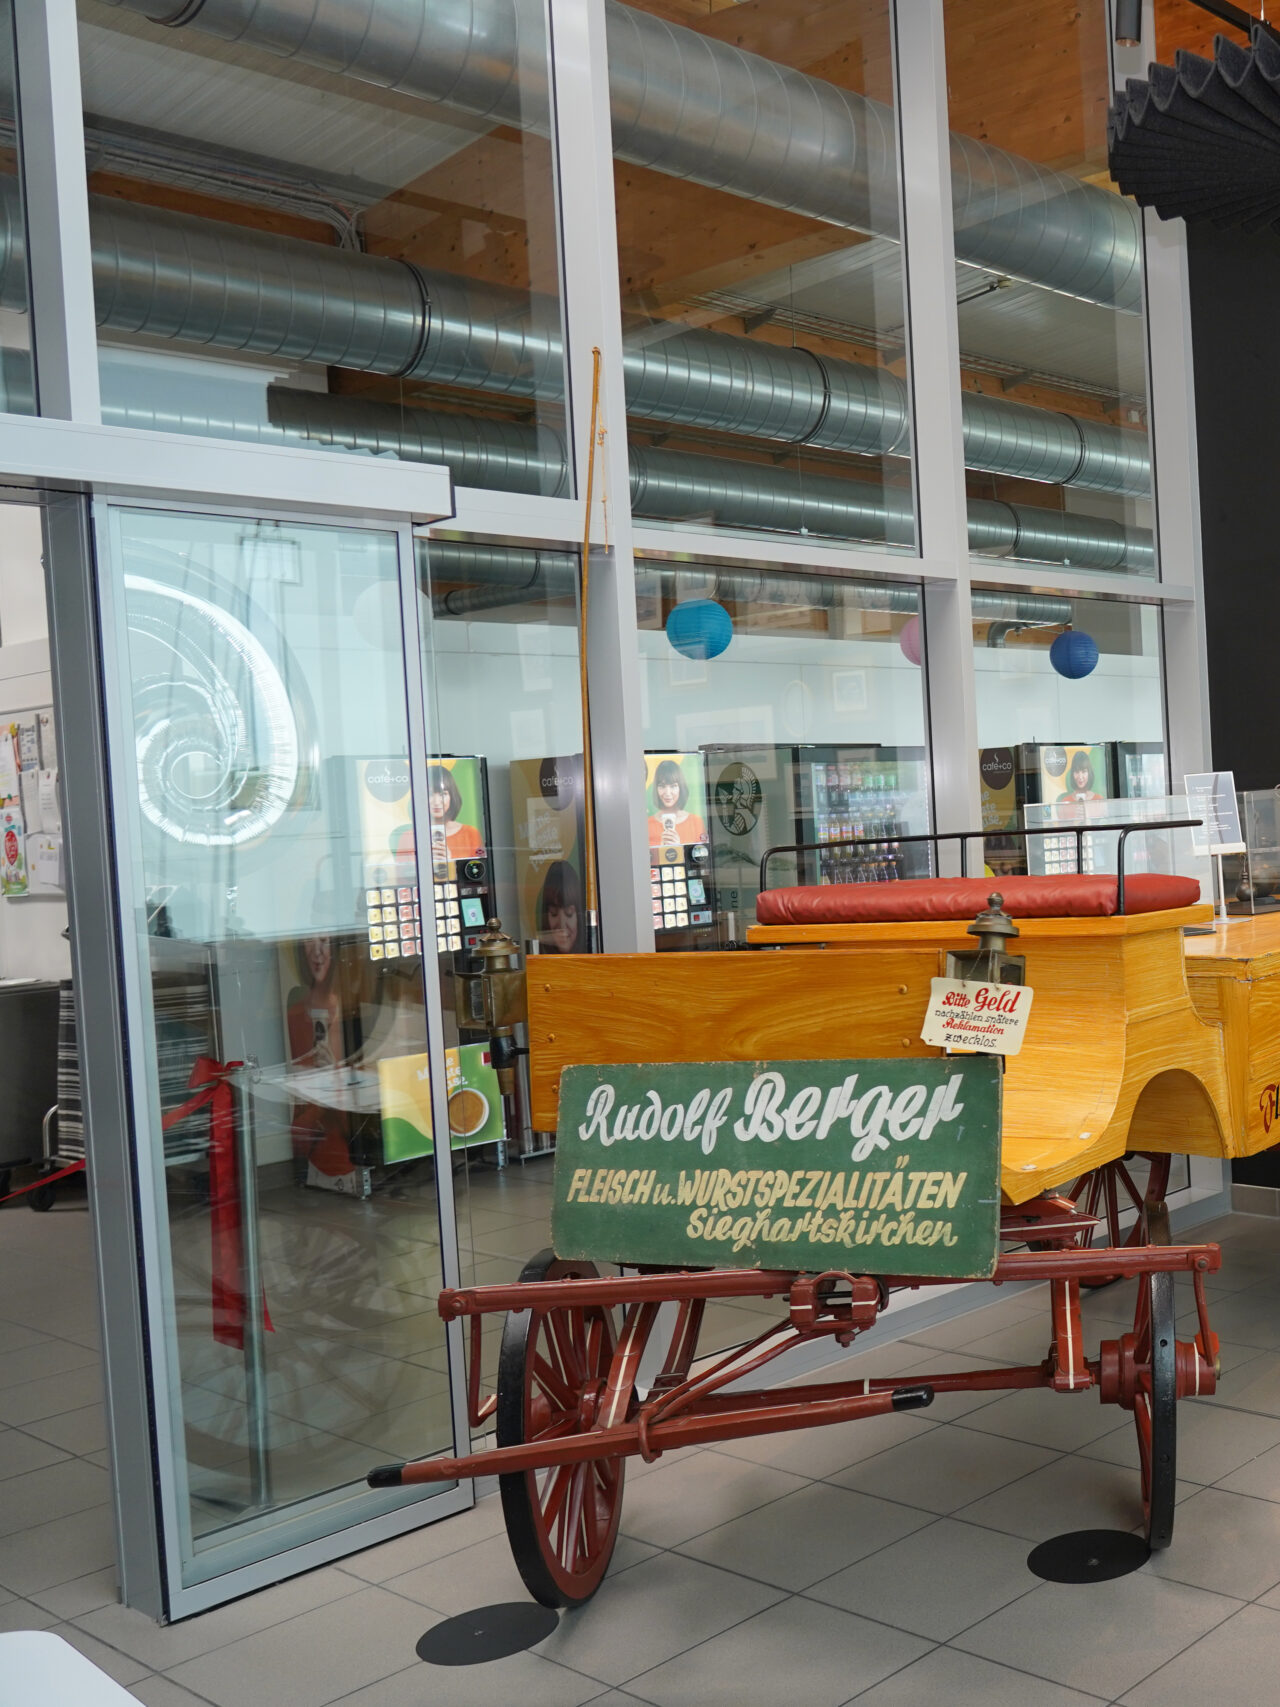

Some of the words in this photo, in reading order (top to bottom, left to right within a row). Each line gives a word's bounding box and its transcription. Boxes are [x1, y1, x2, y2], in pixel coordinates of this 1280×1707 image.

[934, 1009, 983, 1022] nachzählen
[985, 1014, 1020, 1026] spätere
[942, 991, 971, 1008] Bitte
[974, 987, 1021, 1013] Geld
[942, 1017, 1005, 1035] Reklamation
[578, 1084, 733, 1155] Rudolf
[733, 1071, 965, 1162] Berger
[567, 1168, 659, 1204] FLEISCH
[653, 1182, 677, 1206] u.
[677, 1155, 968, 1212] WURSTSPEZIALITÄTEN
[686, 1208, 959, 1253] Sieghartskirchen
